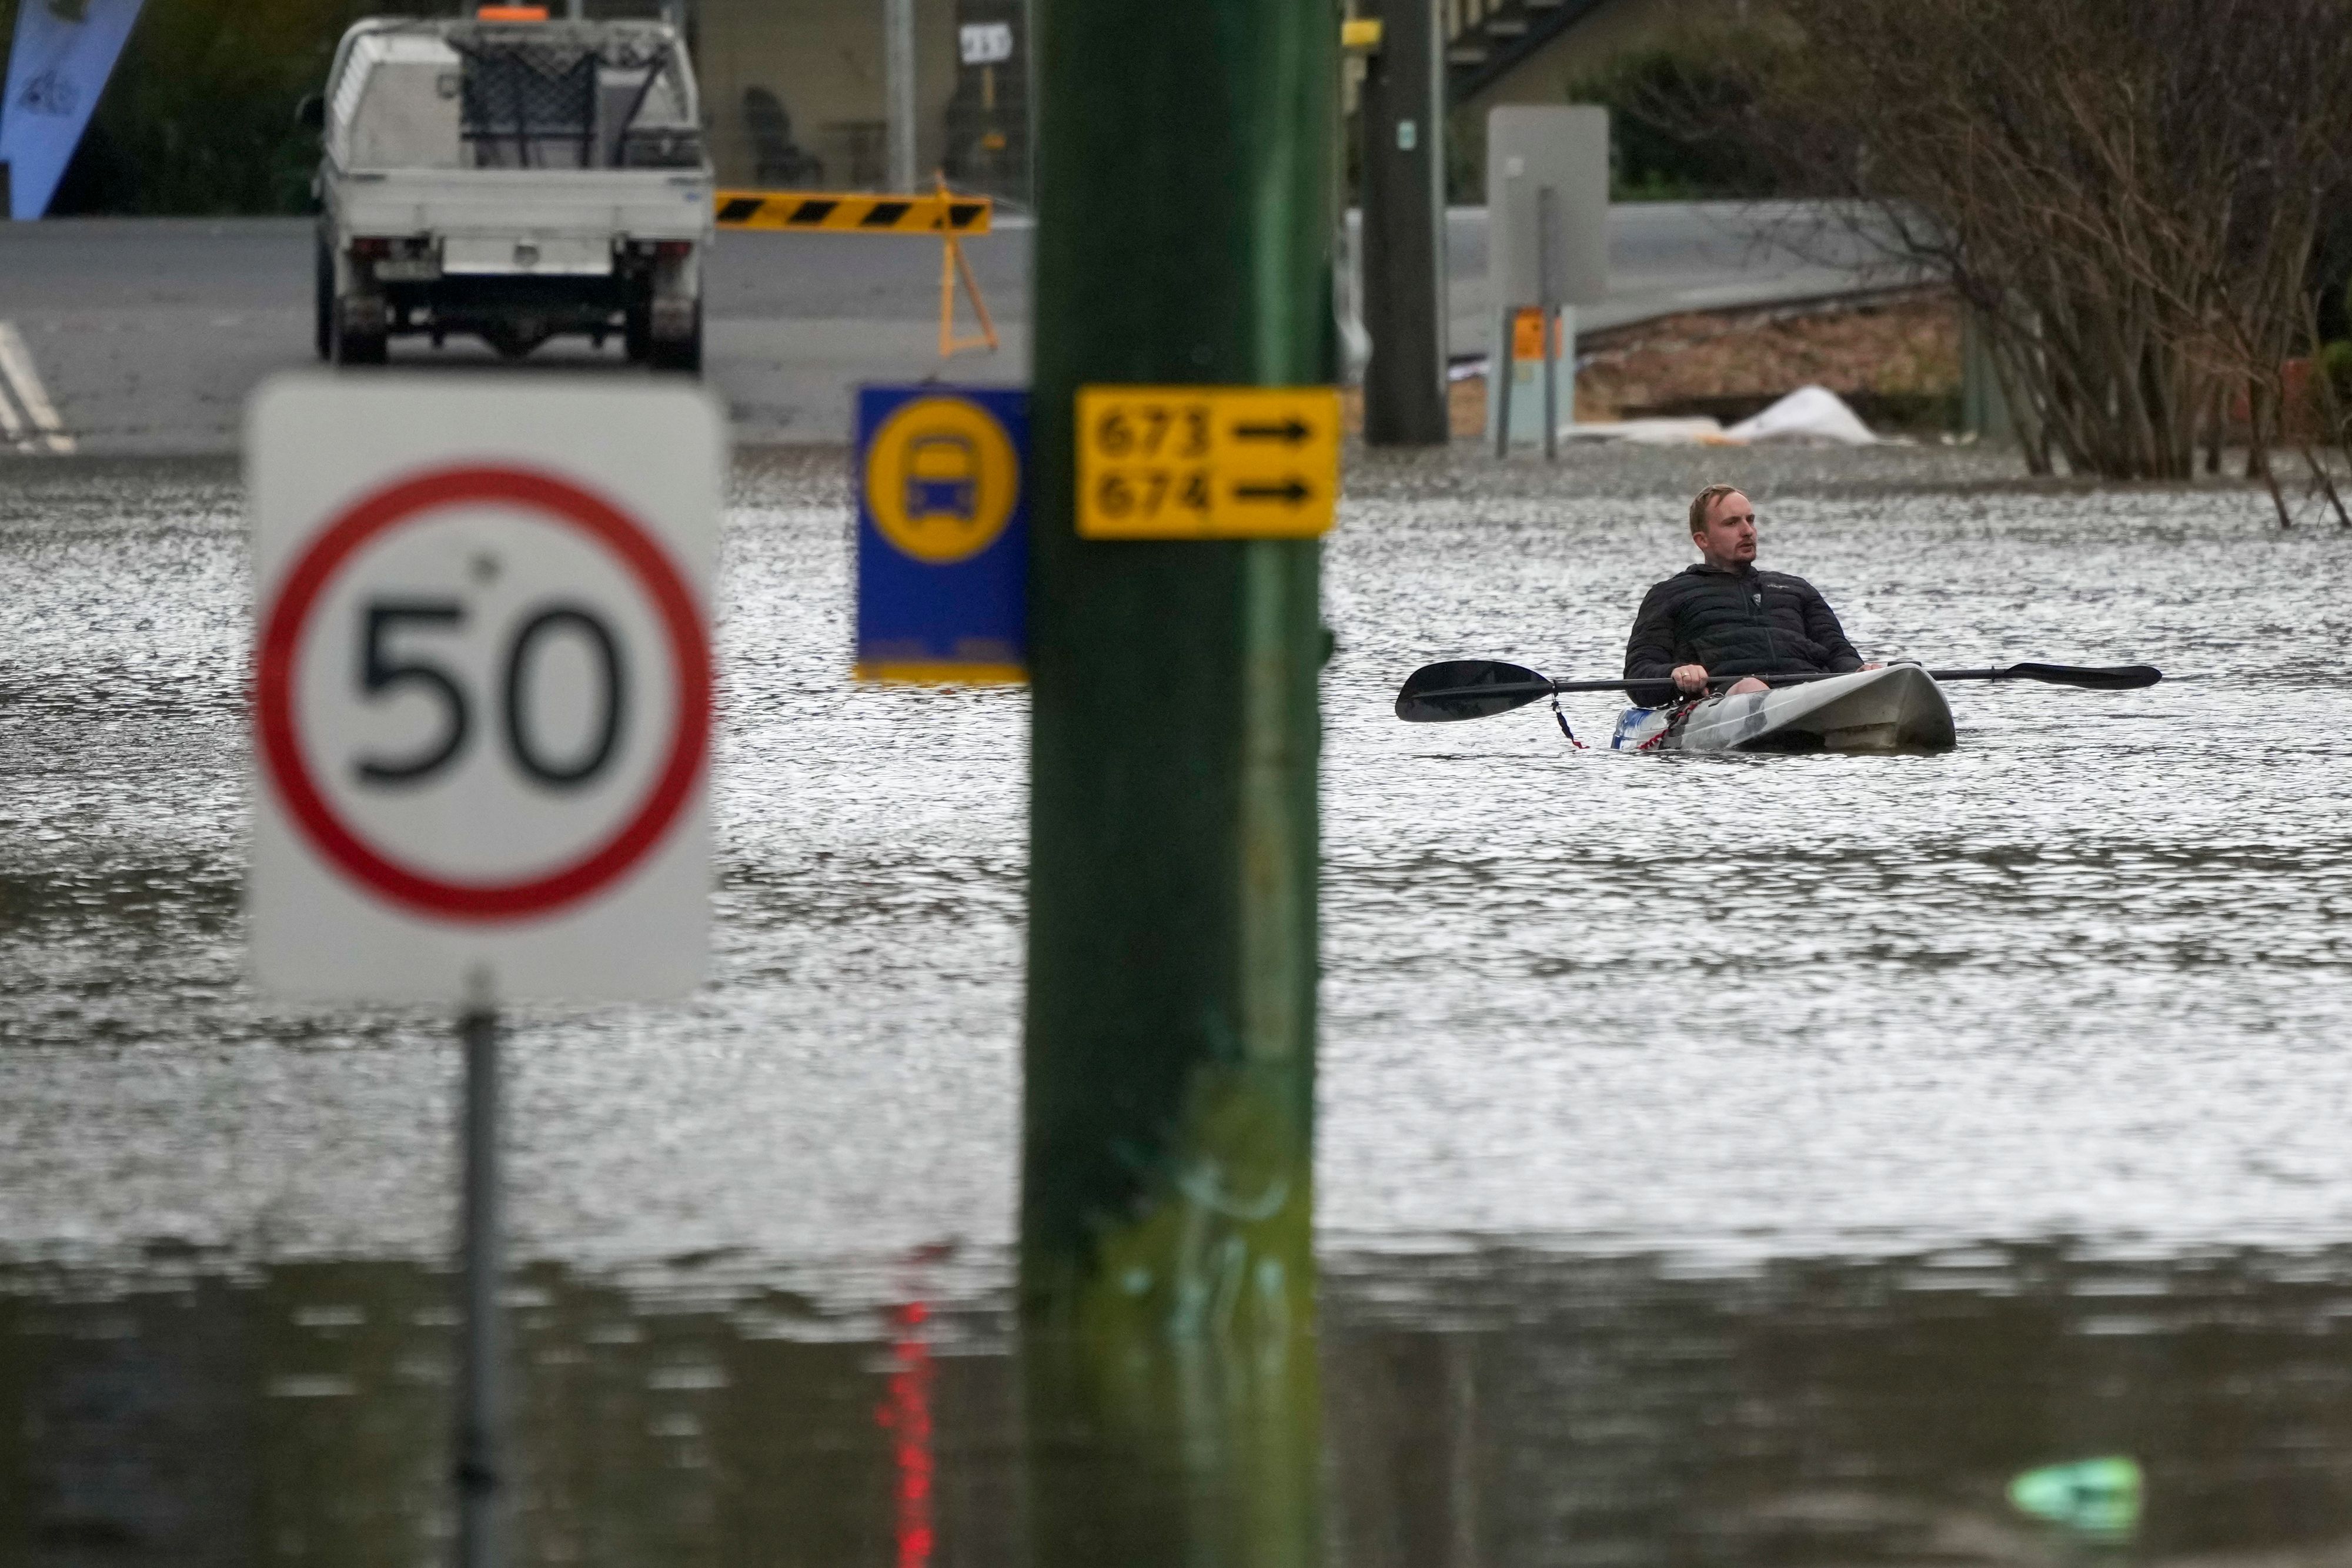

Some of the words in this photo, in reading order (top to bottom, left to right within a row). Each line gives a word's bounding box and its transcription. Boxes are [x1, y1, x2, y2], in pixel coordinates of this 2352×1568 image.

[1097, 405, 1211, 458] 673
[1097, 469, 1211, 519] 674
[352, 597, 630, 793] 50
